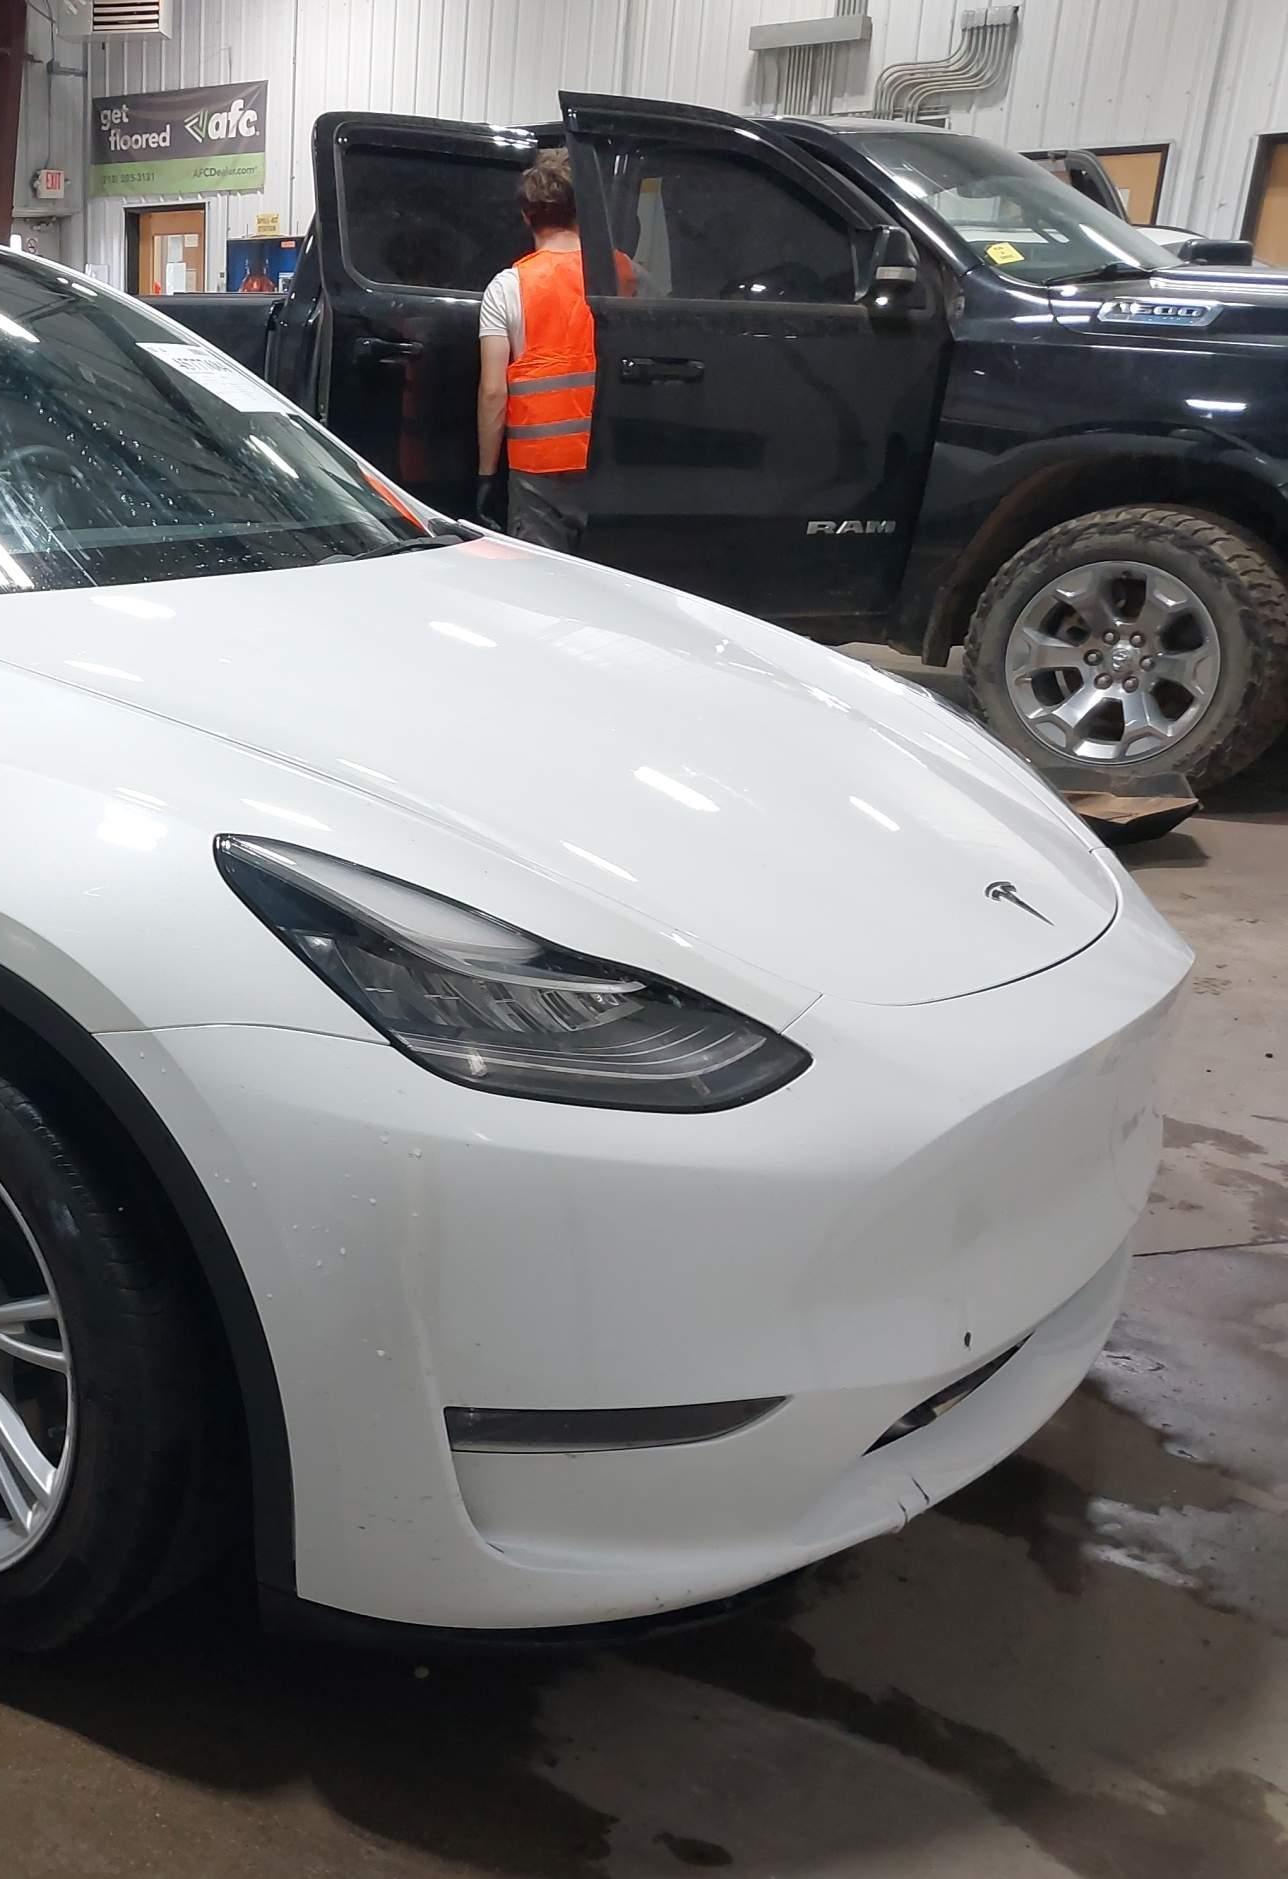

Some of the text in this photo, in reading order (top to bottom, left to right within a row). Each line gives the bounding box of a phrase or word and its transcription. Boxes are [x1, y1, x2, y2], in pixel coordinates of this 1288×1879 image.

[100, 104, 129, 131] get
[109, 124, 171, 151] floored
[806, 520, 896, 535] RAM
